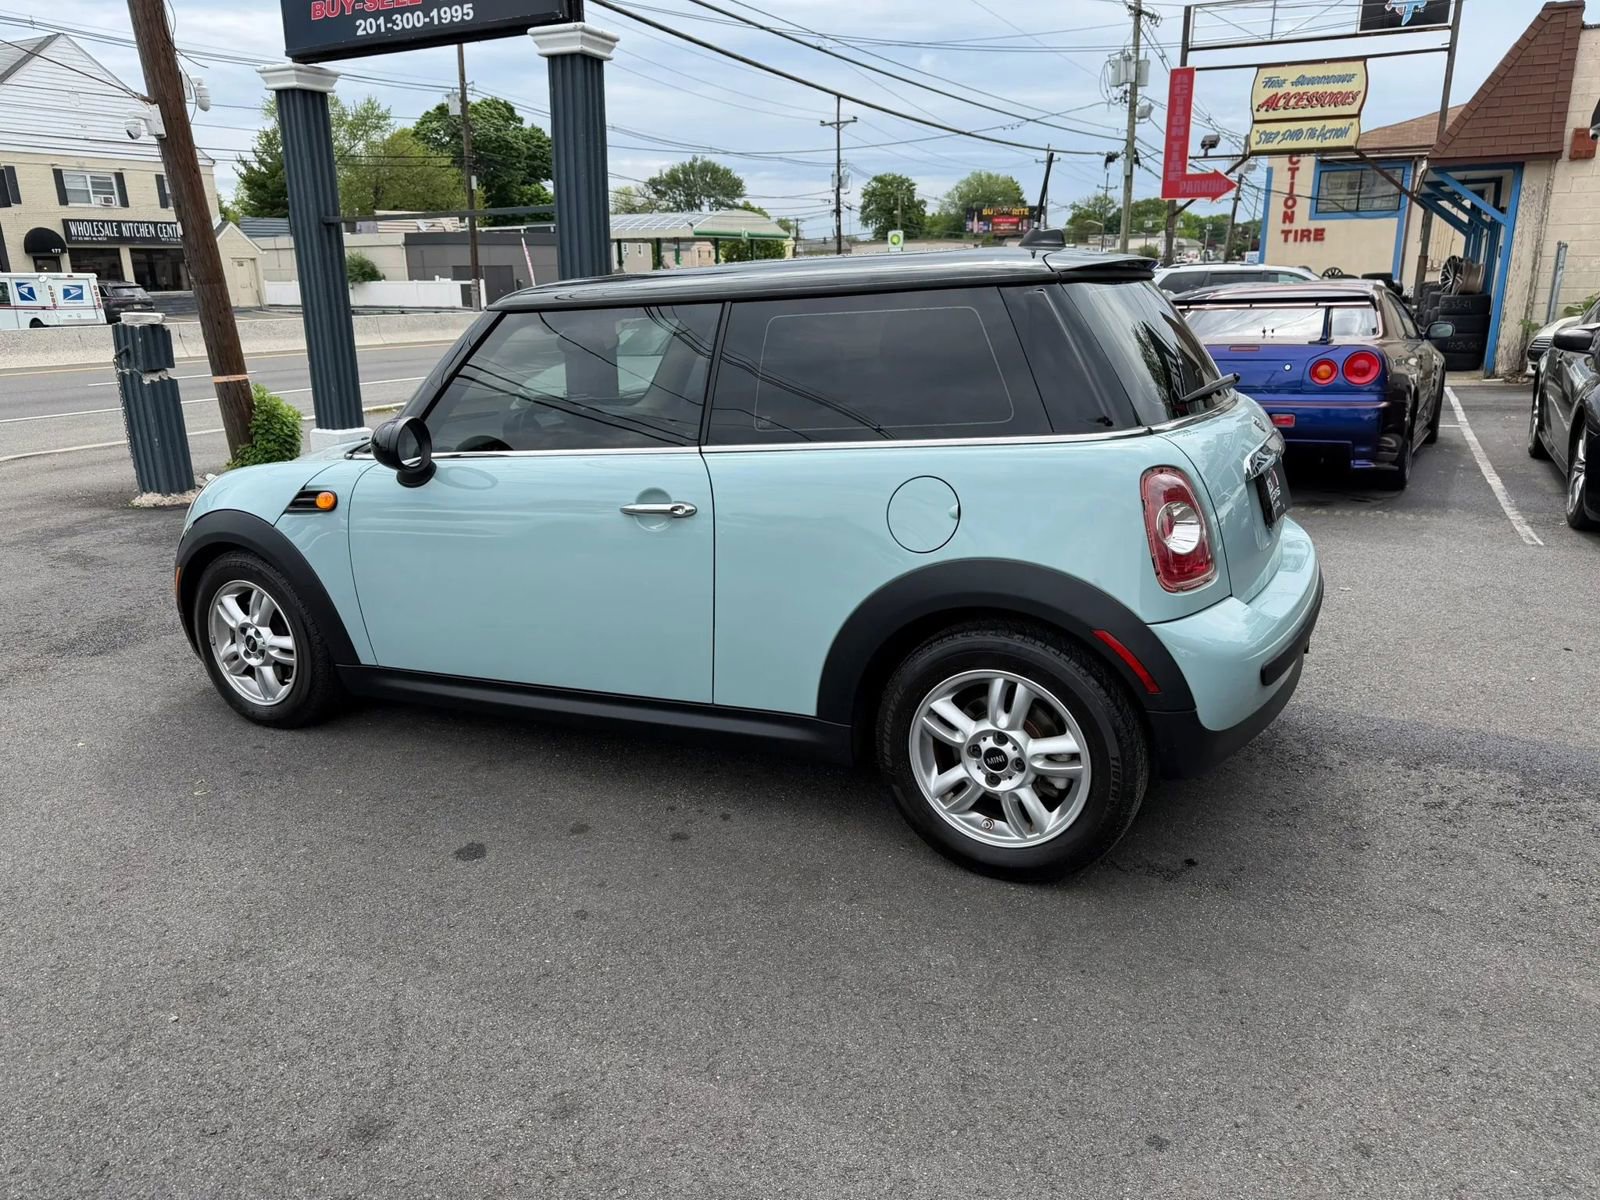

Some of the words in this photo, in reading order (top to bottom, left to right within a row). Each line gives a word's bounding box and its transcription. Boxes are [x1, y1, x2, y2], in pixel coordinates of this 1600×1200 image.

[311, 0, 422, 20] BUY-SE
[355, 3, 475, 36] 201-300-1995
[1255, 90, 1361, 112] ACCESSORIES
[1179, 179, 1228, 194] PARKING
[68, 221, 118, 236] WHOLESALE
[121, 223, 155, 237] KITCHEN
[1280, 228, 1325, 243] TIRE
[986, 755, 1005, 765] MINI
